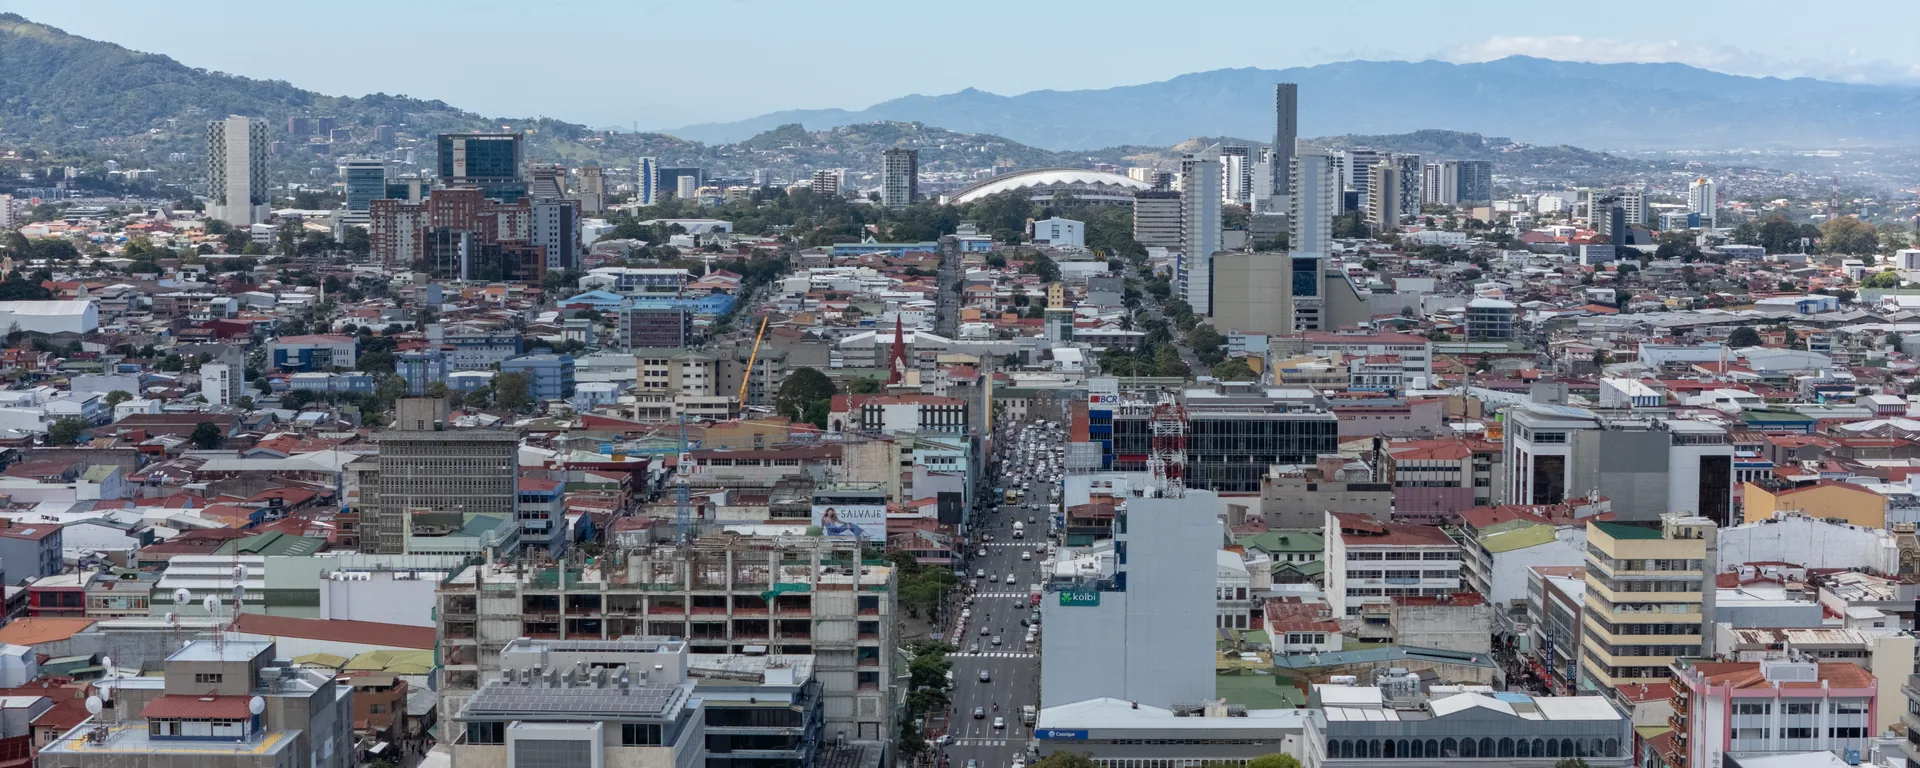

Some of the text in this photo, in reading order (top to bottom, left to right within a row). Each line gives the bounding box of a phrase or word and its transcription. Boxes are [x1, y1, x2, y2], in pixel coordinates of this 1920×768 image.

[1100, 395, 1118, 403] BCR
[840, 509, 882, 519] SALVAJE
[1072, 592, 1096, 601] kölbi
